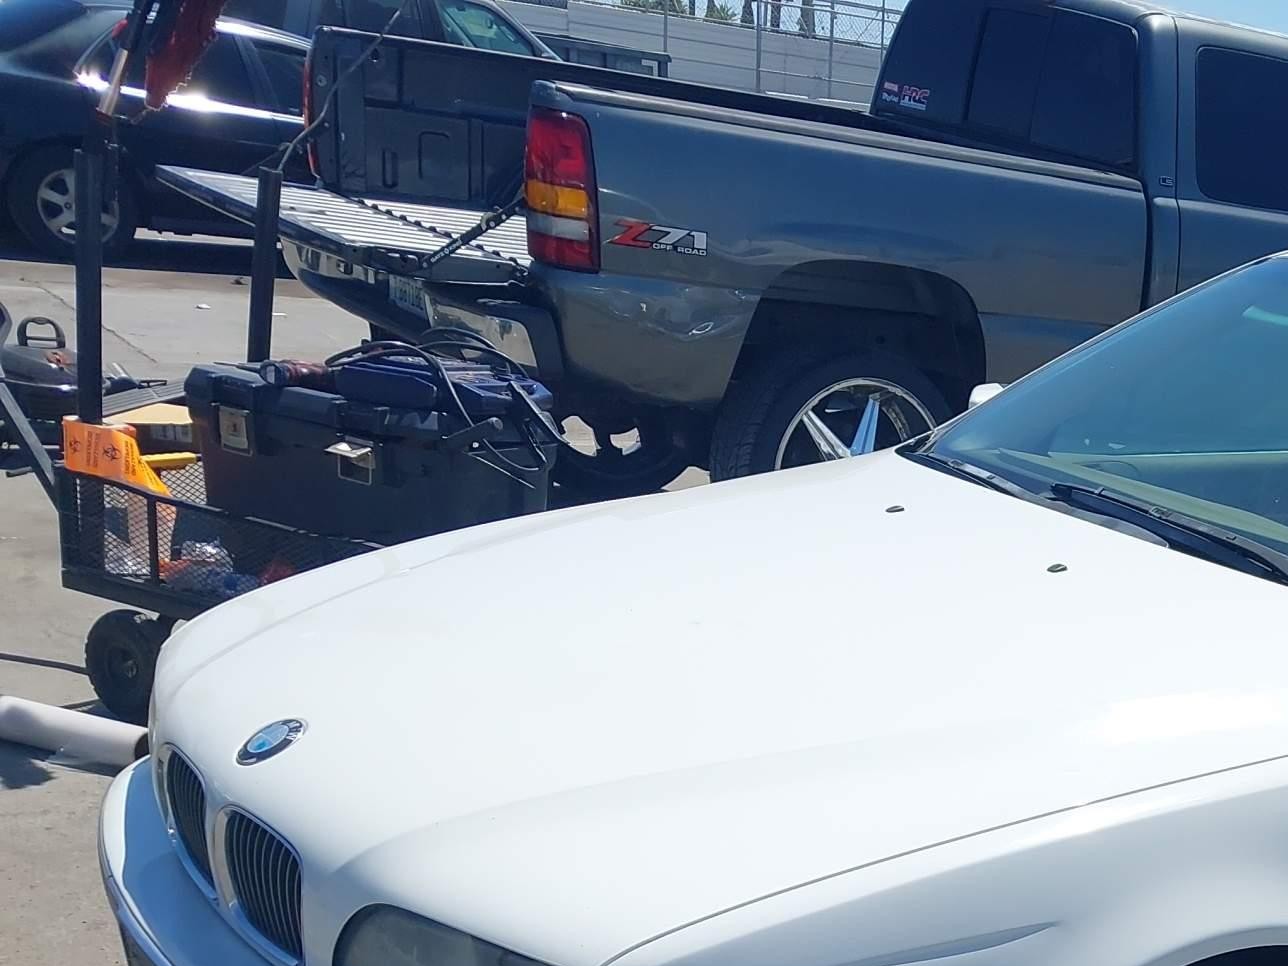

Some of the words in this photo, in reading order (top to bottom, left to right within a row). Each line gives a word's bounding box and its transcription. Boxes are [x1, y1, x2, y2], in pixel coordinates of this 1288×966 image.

[609, 218, 708, 250] Z71
[652, 242, 674, 251] OFF
[677, 246, 708, 256] ROAD
